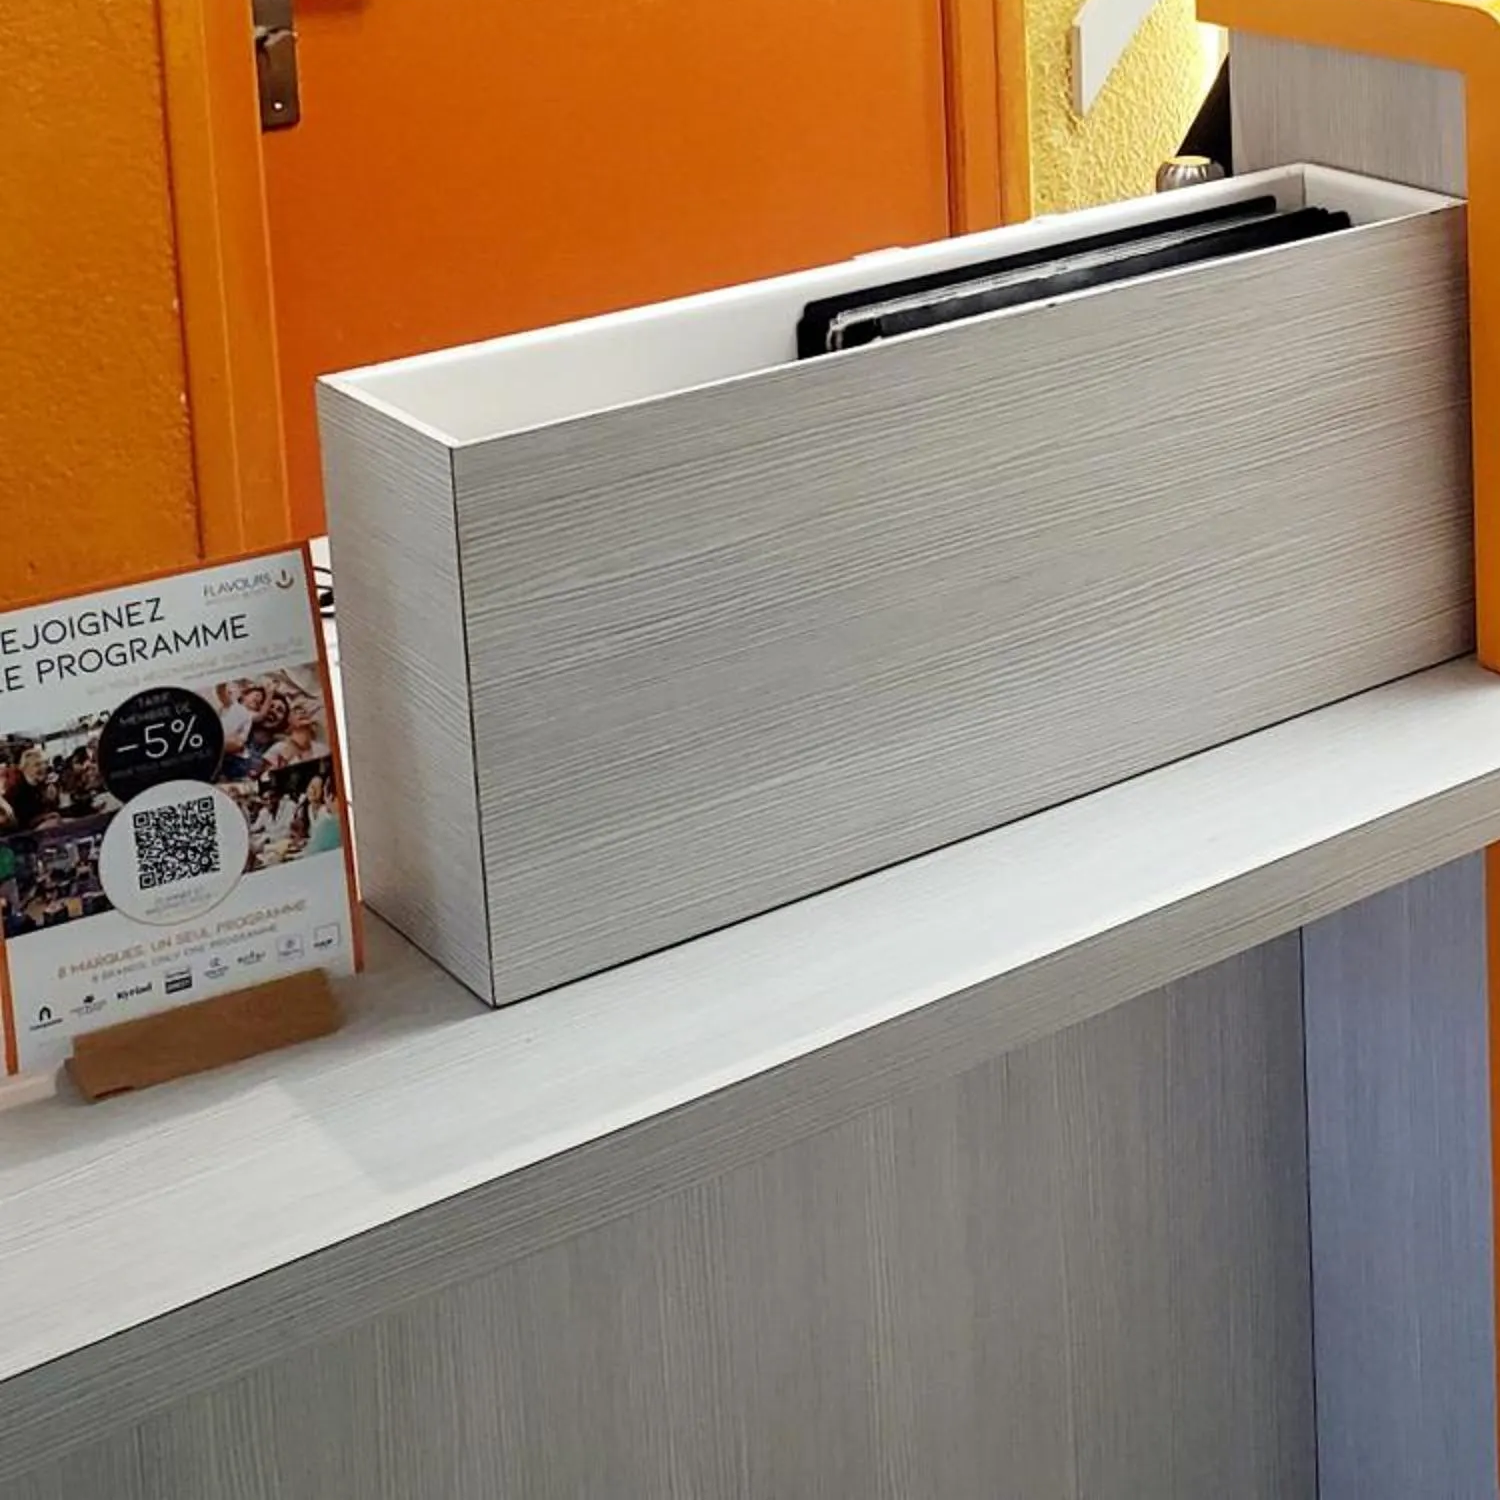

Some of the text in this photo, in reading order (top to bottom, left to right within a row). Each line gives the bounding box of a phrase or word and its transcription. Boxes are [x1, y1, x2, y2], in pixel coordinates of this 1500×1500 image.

[0, 597, 165, 654] EJOIGNEZ
[0, 665, 25, 695] E
[37, 613, 250, 684] PROGRAMME
[116, 714, 204, 759] -5%
